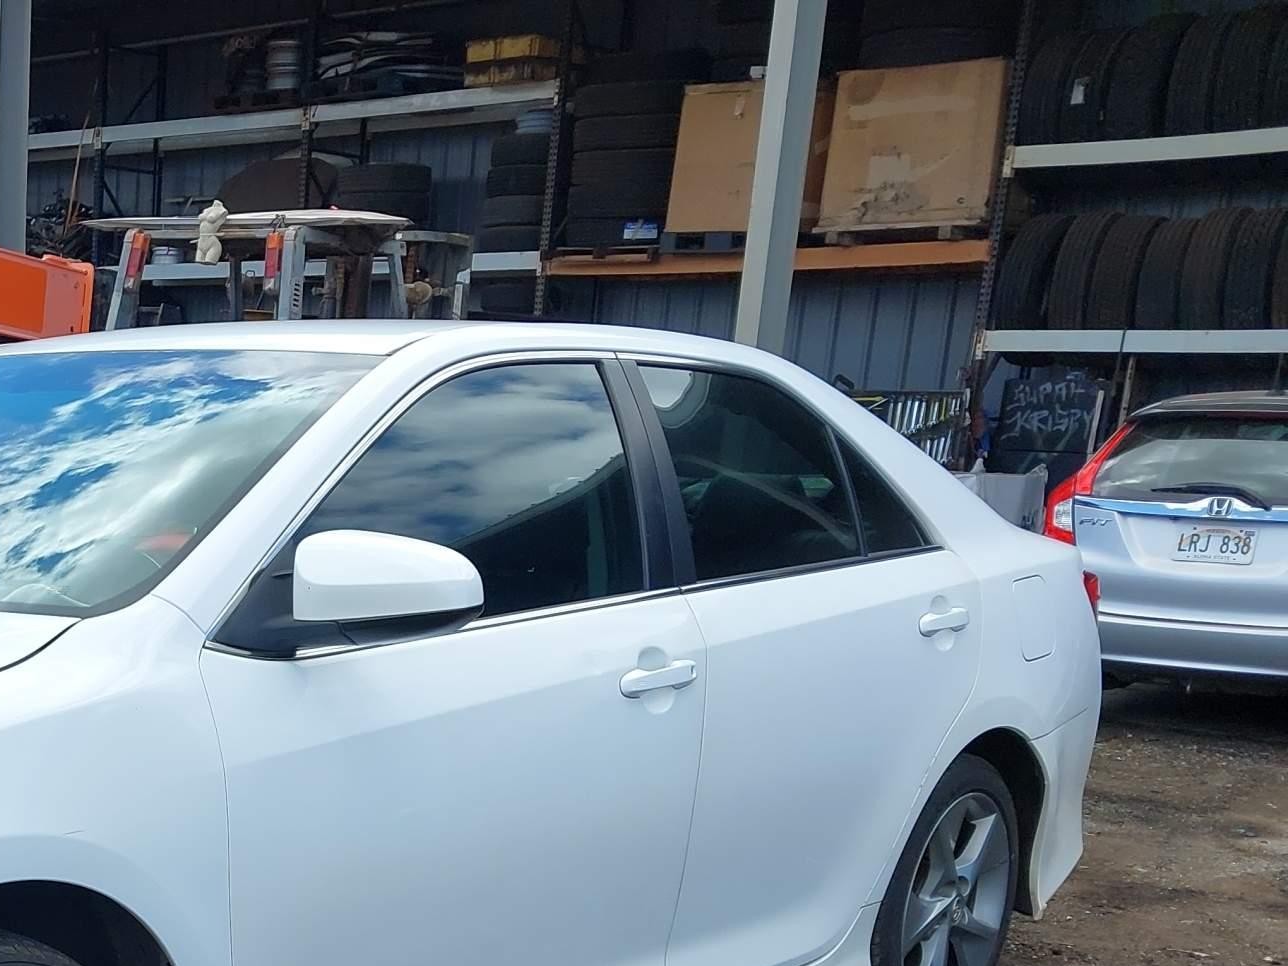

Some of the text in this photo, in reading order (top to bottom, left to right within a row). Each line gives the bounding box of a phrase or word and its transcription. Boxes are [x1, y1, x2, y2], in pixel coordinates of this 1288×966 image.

[1000, 404, 1094, 442] KRISPY
[1177, 533, 1252, 555] LRJ 838
